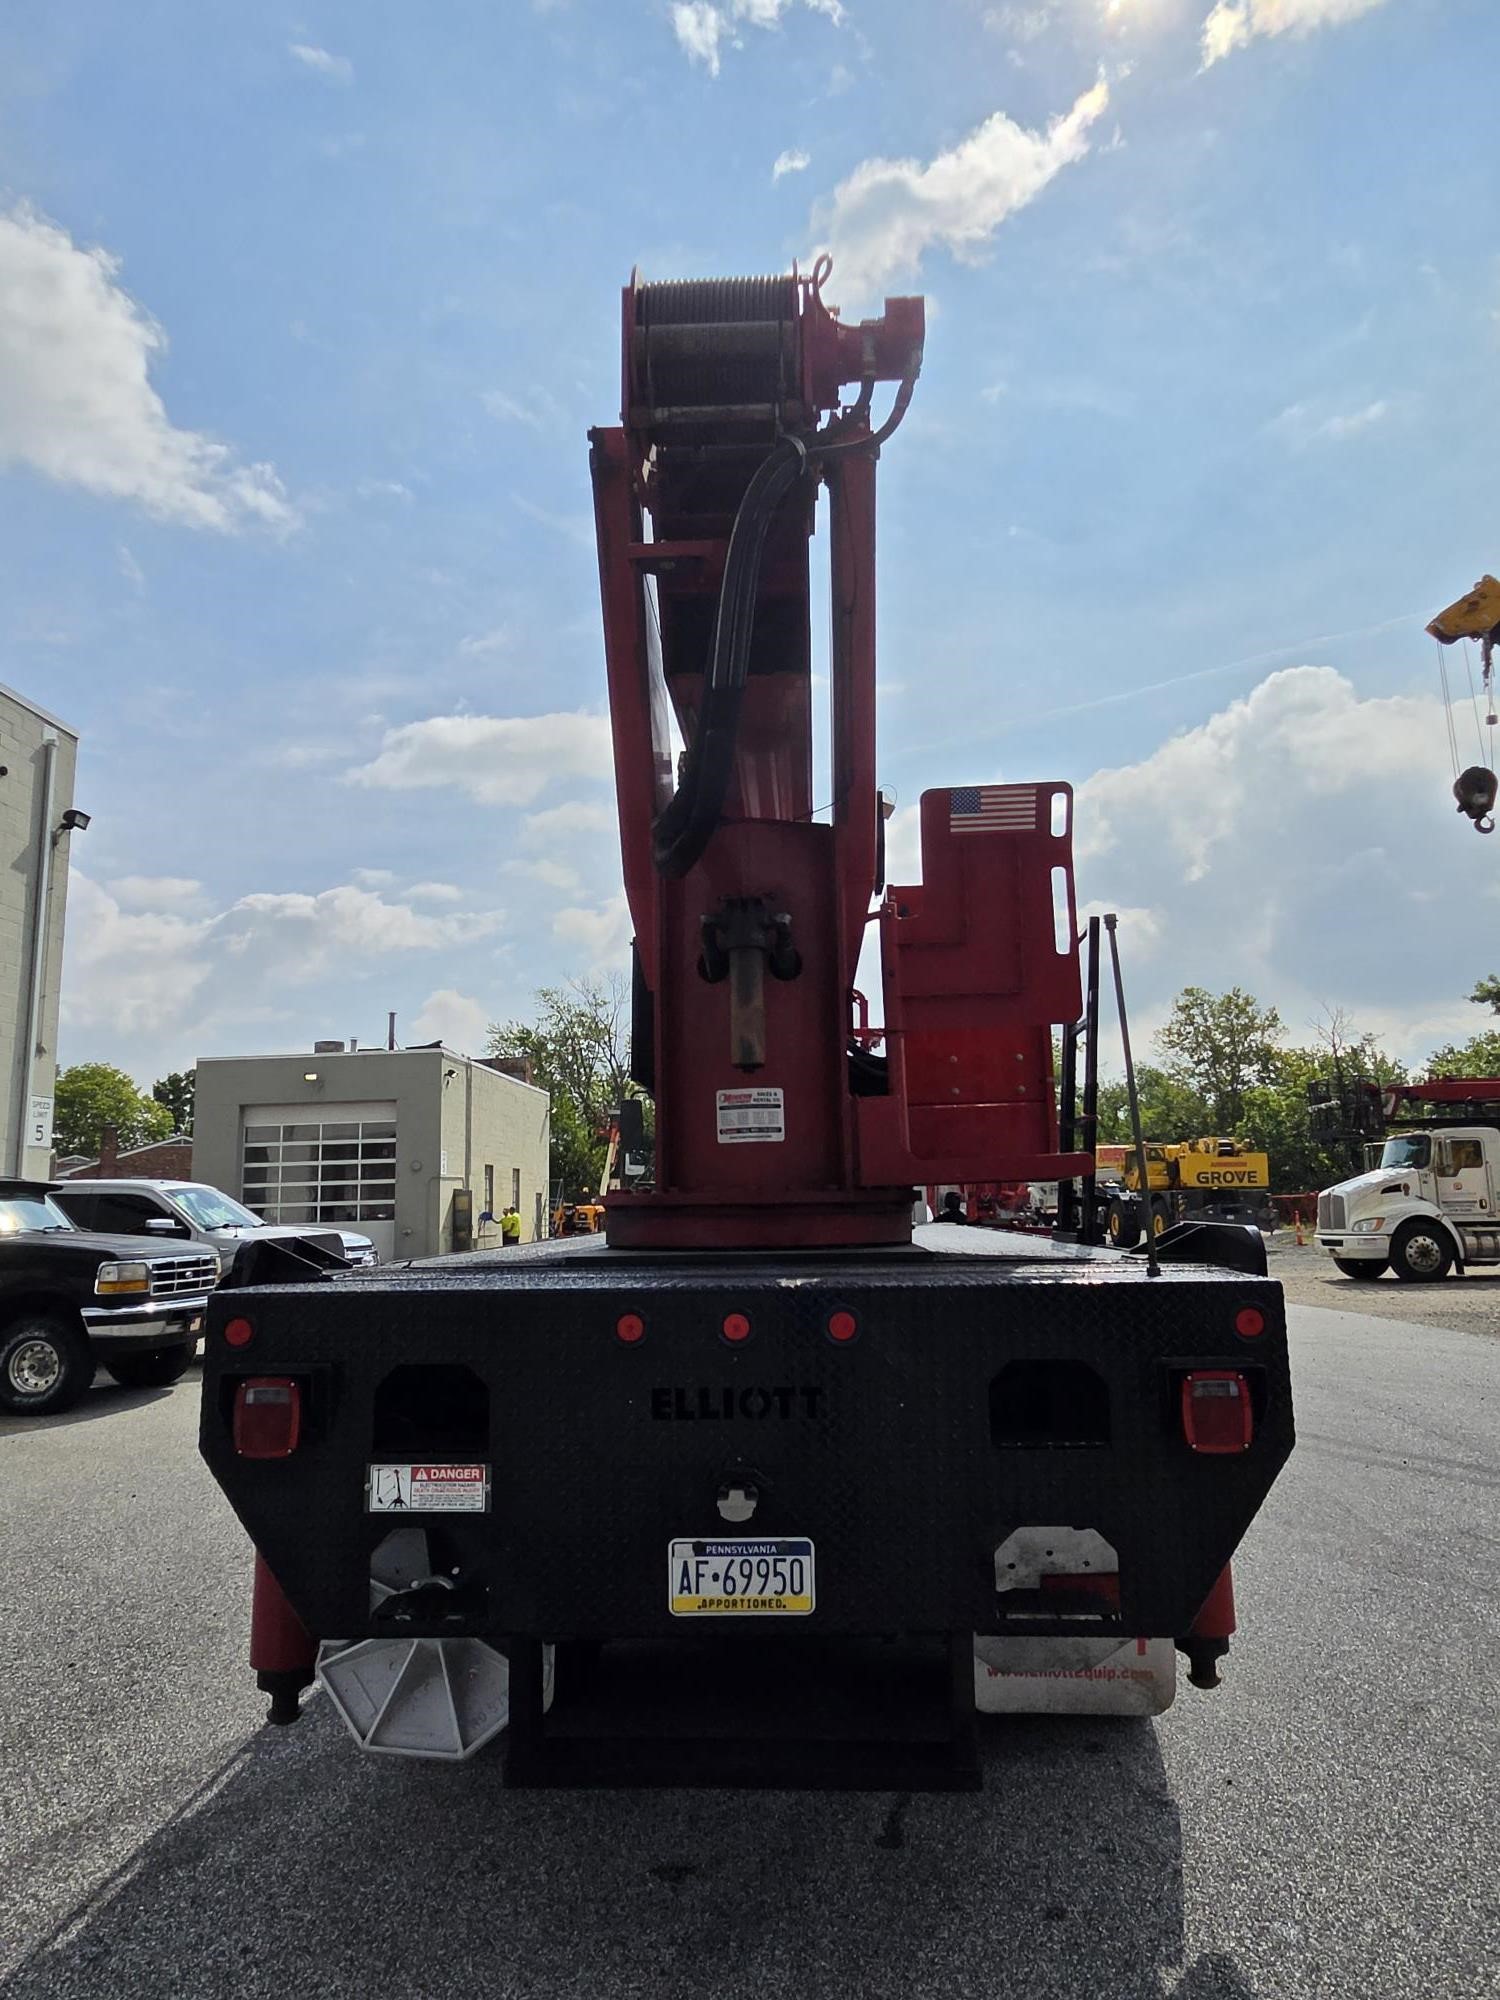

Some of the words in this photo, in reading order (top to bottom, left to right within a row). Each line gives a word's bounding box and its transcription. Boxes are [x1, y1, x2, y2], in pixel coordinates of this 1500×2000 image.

[32, 1100, 50, 1110] SPEED
[35, 1124, 44, 1141] 5
[1196, 1170, 1258, 1184] GROVE
[651, 1386, 823, 1419] ELLIOTT
[430, 1468, 480, 1480] DANGER
[705, 1544, 778, 1555] PENNSYLVANIA
